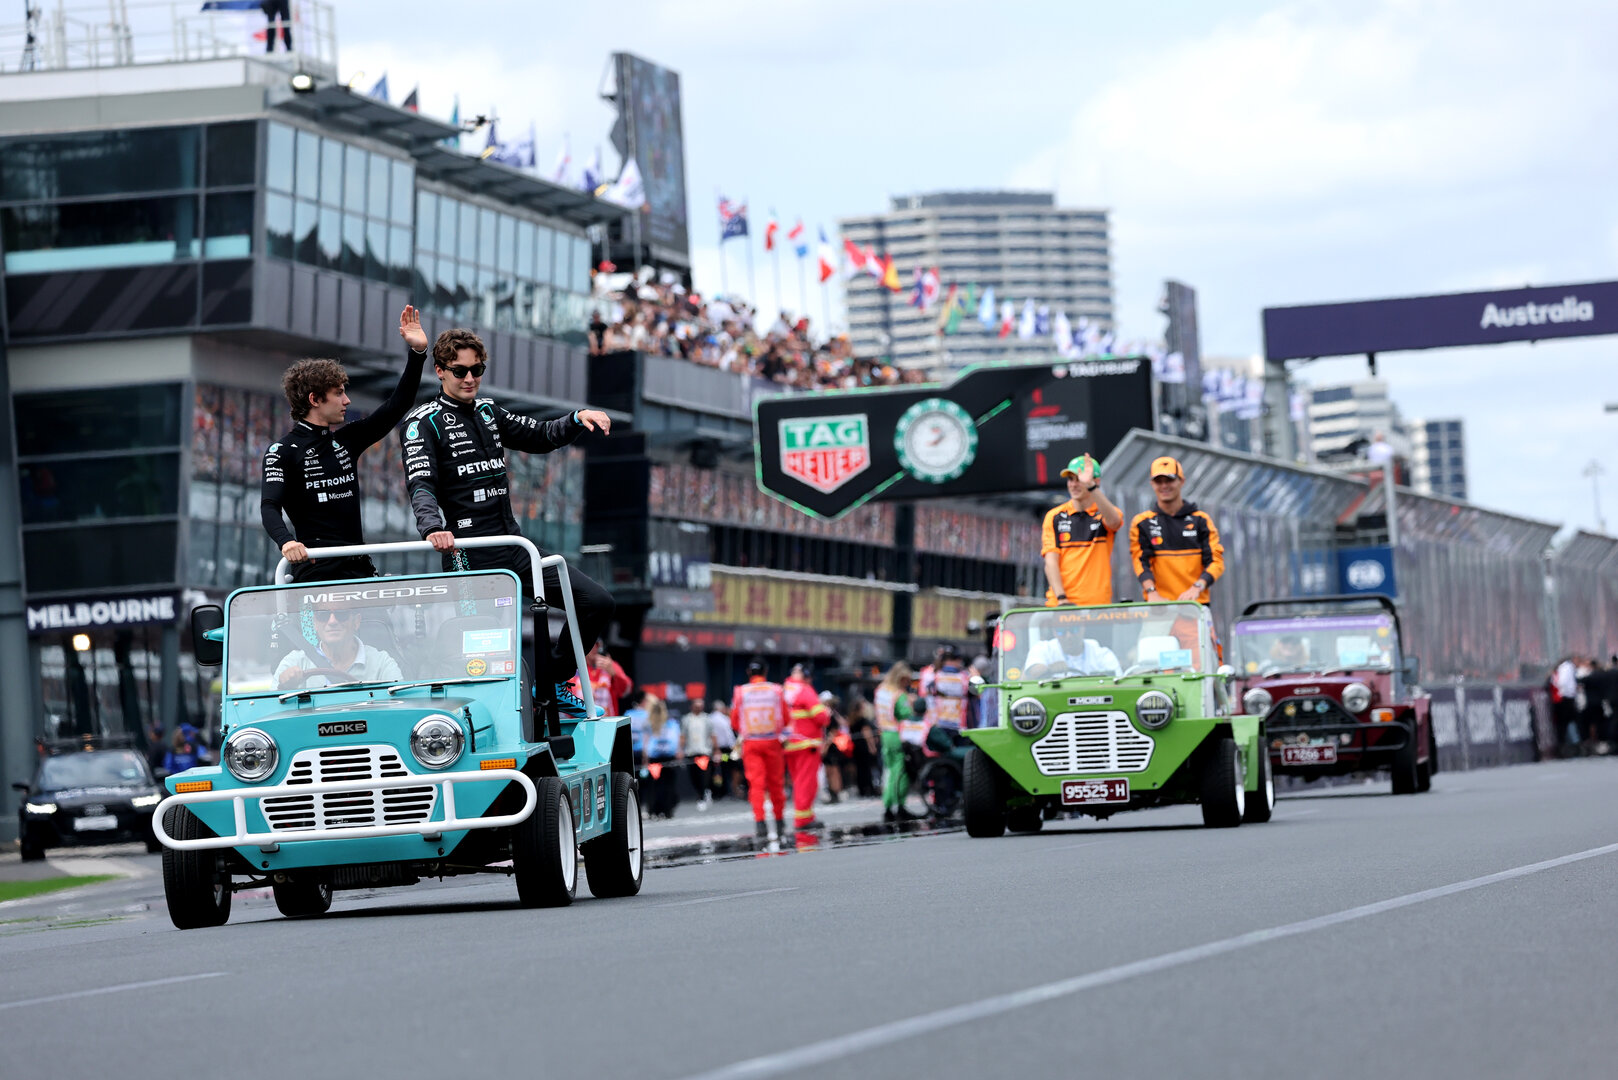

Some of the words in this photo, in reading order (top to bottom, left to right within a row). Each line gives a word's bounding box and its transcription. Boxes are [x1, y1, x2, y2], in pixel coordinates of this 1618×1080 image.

[1480, 296, 1594, 329] Australia
[787, 421, 860, 446] TAG
[785, 447, 866, 489] HEUER
[305, 473, 355, 490] PETRONAS
[328, 489, 354, 500] Microsoft
[303, 584, 448, 604] MERCEDES
[27, 596, 176, 630] MELBOURNE
[320, 723, 365, 734] MOKE
